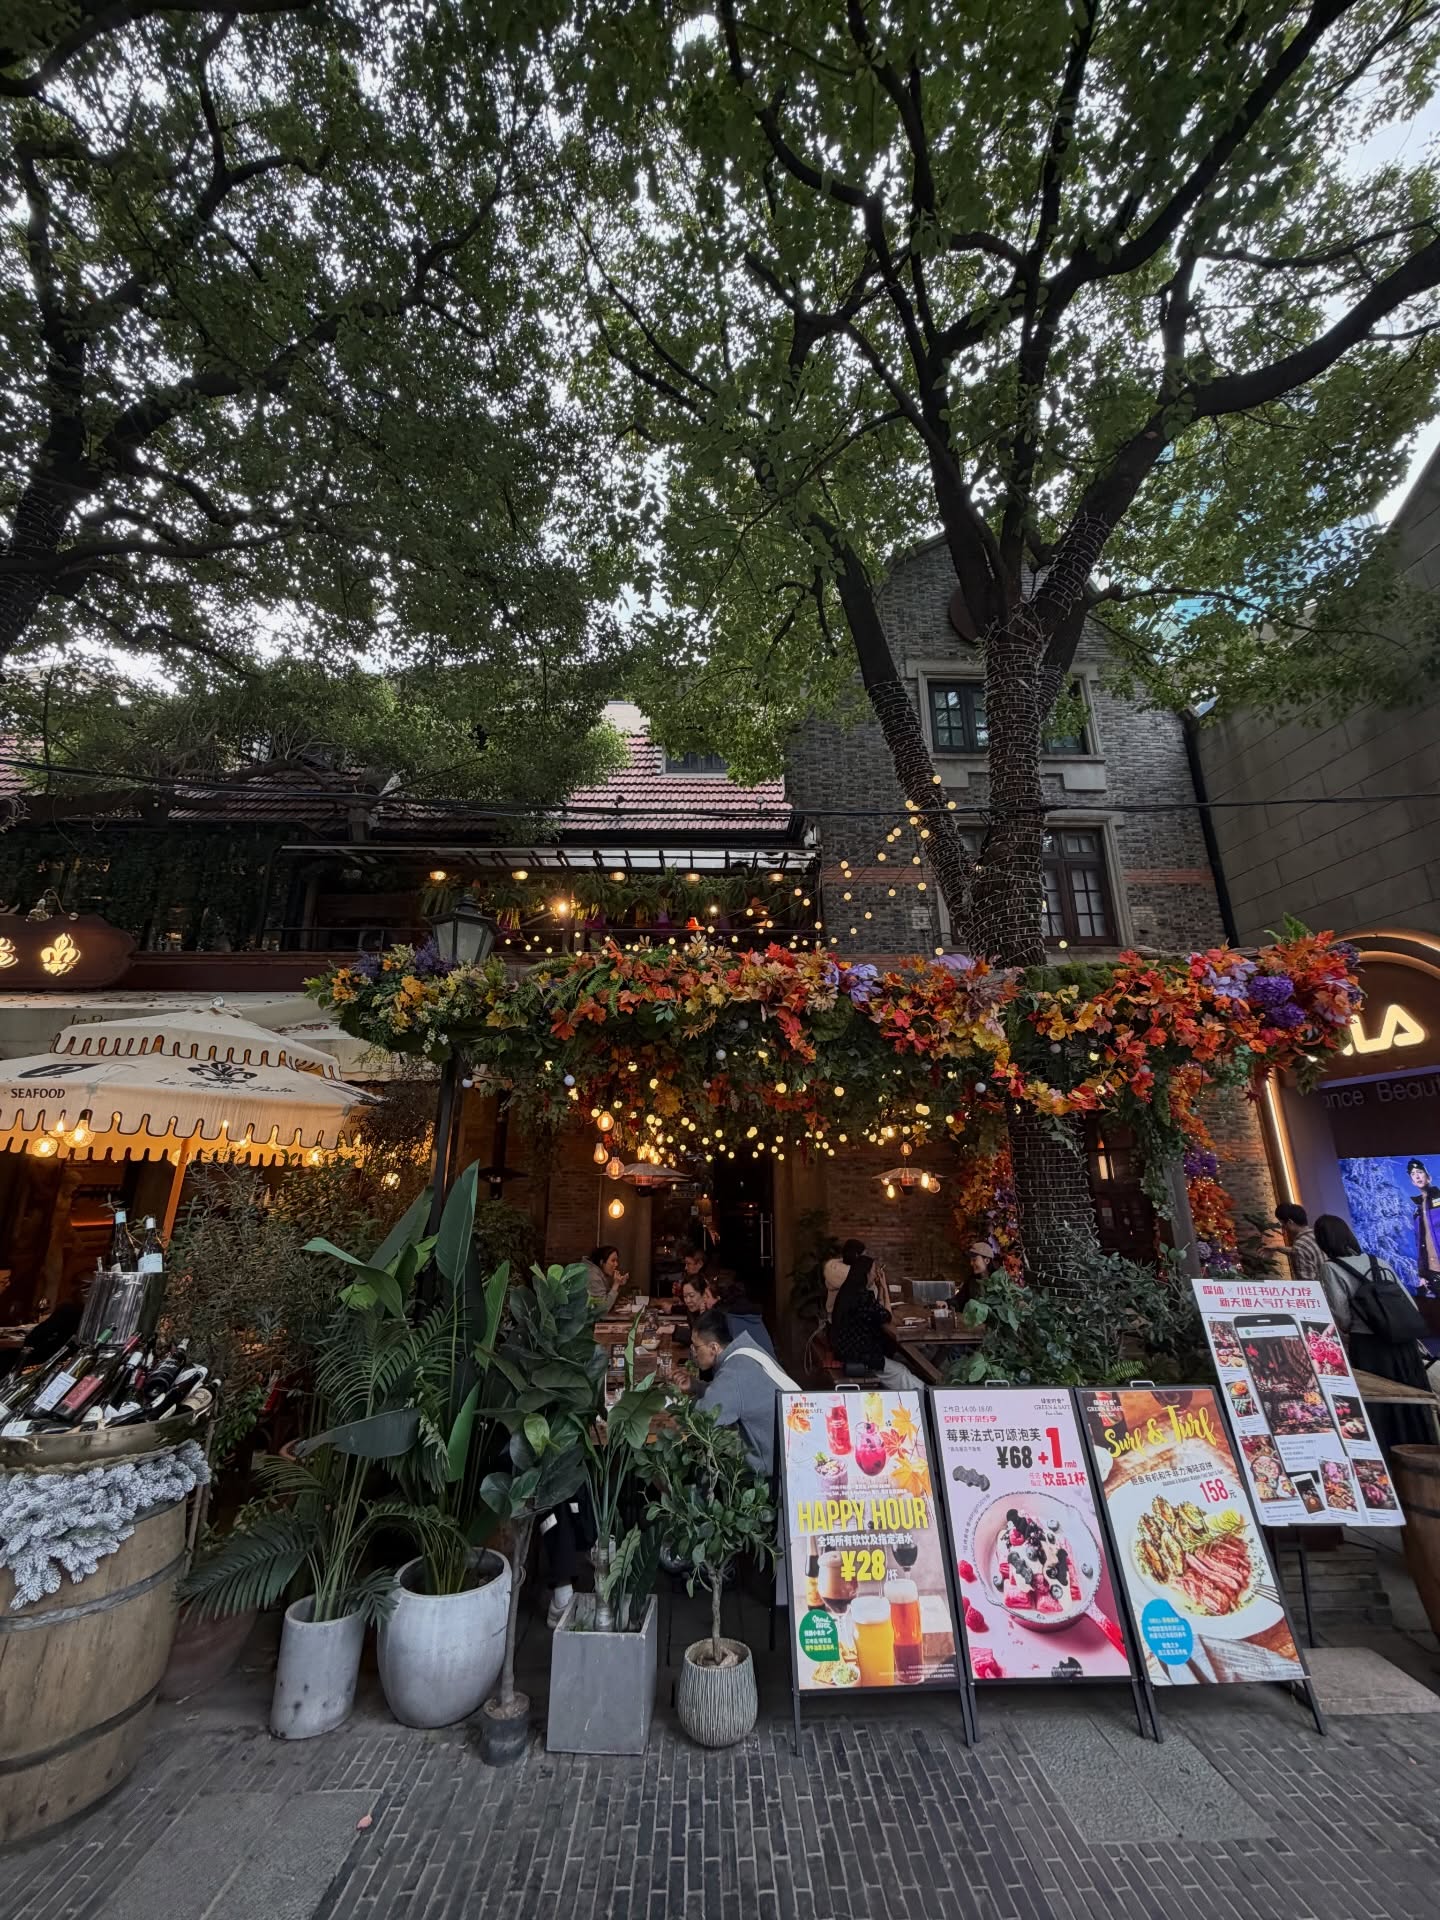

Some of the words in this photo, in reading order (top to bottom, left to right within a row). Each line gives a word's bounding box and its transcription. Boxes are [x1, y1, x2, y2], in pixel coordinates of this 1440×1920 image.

[11, 1088, 65, 1098] SEAFOOD
[945, 1428, 1042, 1443] 莓果法式可颂泡芙
[1104, 1427, 1146, 1458] Surf
[1146, 1418, 1169, 1446] &
[1161, 1404, 1217, 1447] Turf
[996, 1445, 1033, 1469] ¥68
[1042, 1471, 1087, 1486] 饮品1杯
[1199, 1478, 1229, 1504] 158
[797, 1499, 865, 1533] HAPPY
[870, 1497, 929, 1531] HOUR
[817, 1532, 914, 1547] 全场所有软饮及指定酒水
[840, 1549, 886, 1582] ¥28
